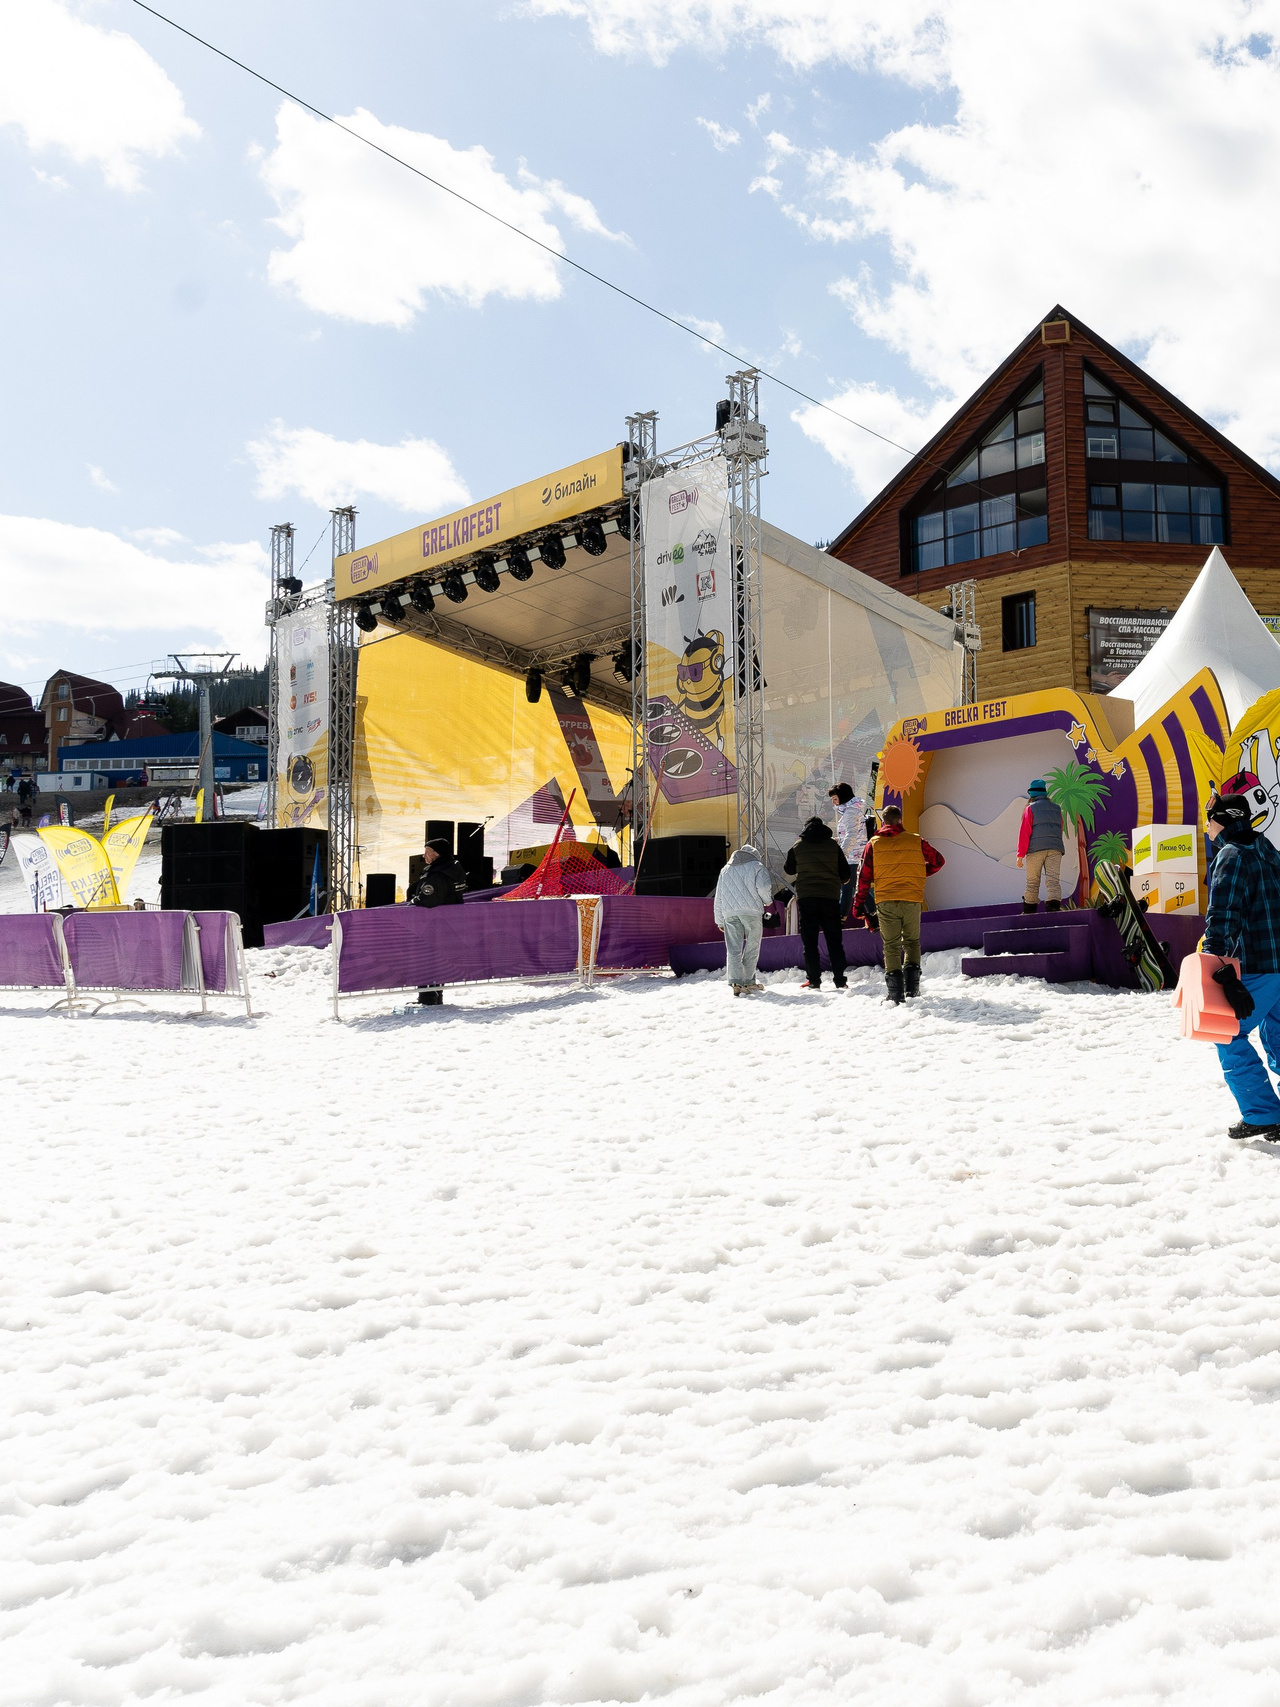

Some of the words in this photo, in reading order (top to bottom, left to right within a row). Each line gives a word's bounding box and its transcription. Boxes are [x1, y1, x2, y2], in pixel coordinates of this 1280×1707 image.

[554, 473, 596, 500] билайн
[423, 502, 502, 557] GRELKAFEST
[656, 546, 684, 565] drivee
[1118, 626, 1162, 634] СПА-МАССАЖ
[1100, 640, 1142, 648] Восстановись
[944, 706, 978, 726] GRELKA
[983, 701, 1006, 720] FEST
[1160, 844, 1177, 852] Лихие
[1178, 844, 1192, 852] 90-е
[1142, 880, 1150, 891] сб
[1175, 882, 1185, 892] ср
[1176, 896, 1184, 906] 17
